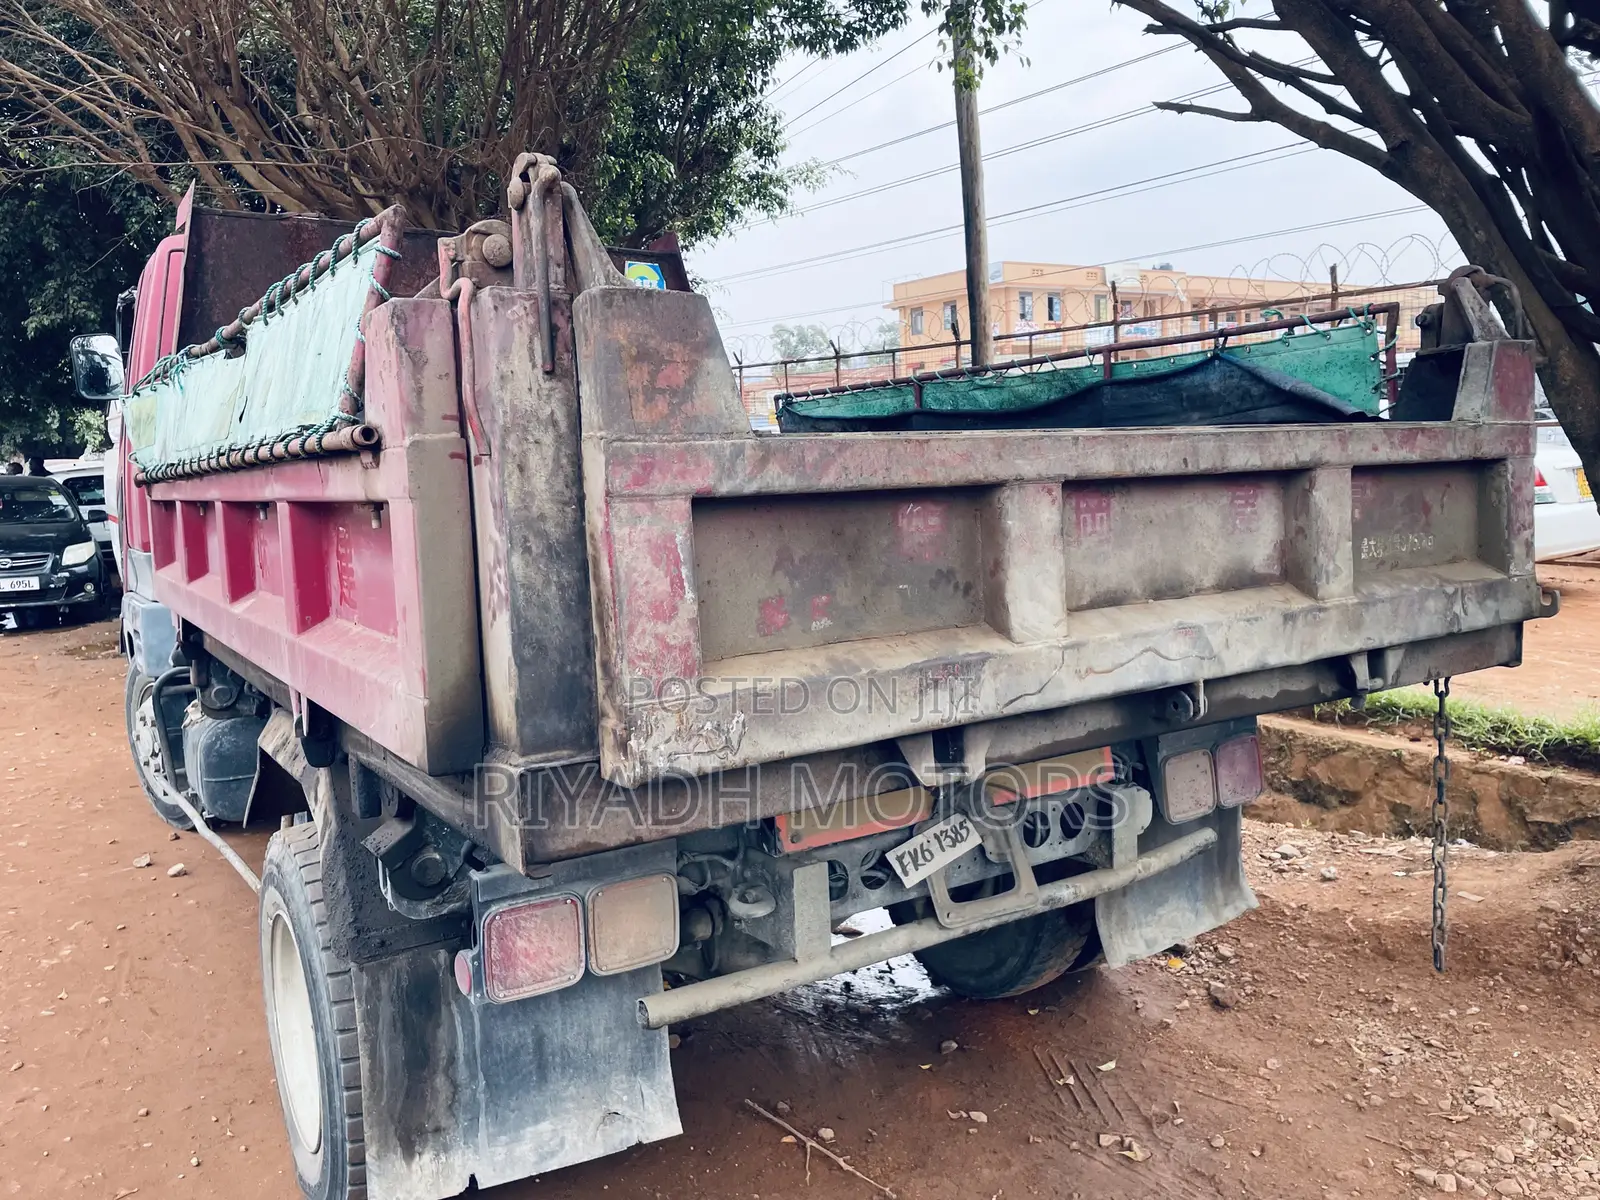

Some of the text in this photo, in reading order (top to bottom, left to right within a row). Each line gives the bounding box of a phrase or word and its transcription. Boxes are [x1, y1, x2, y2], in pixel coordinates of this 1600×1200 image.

[10, 579, 34, 589] 695L
[895, 818, 970, 877] FK6 1385
